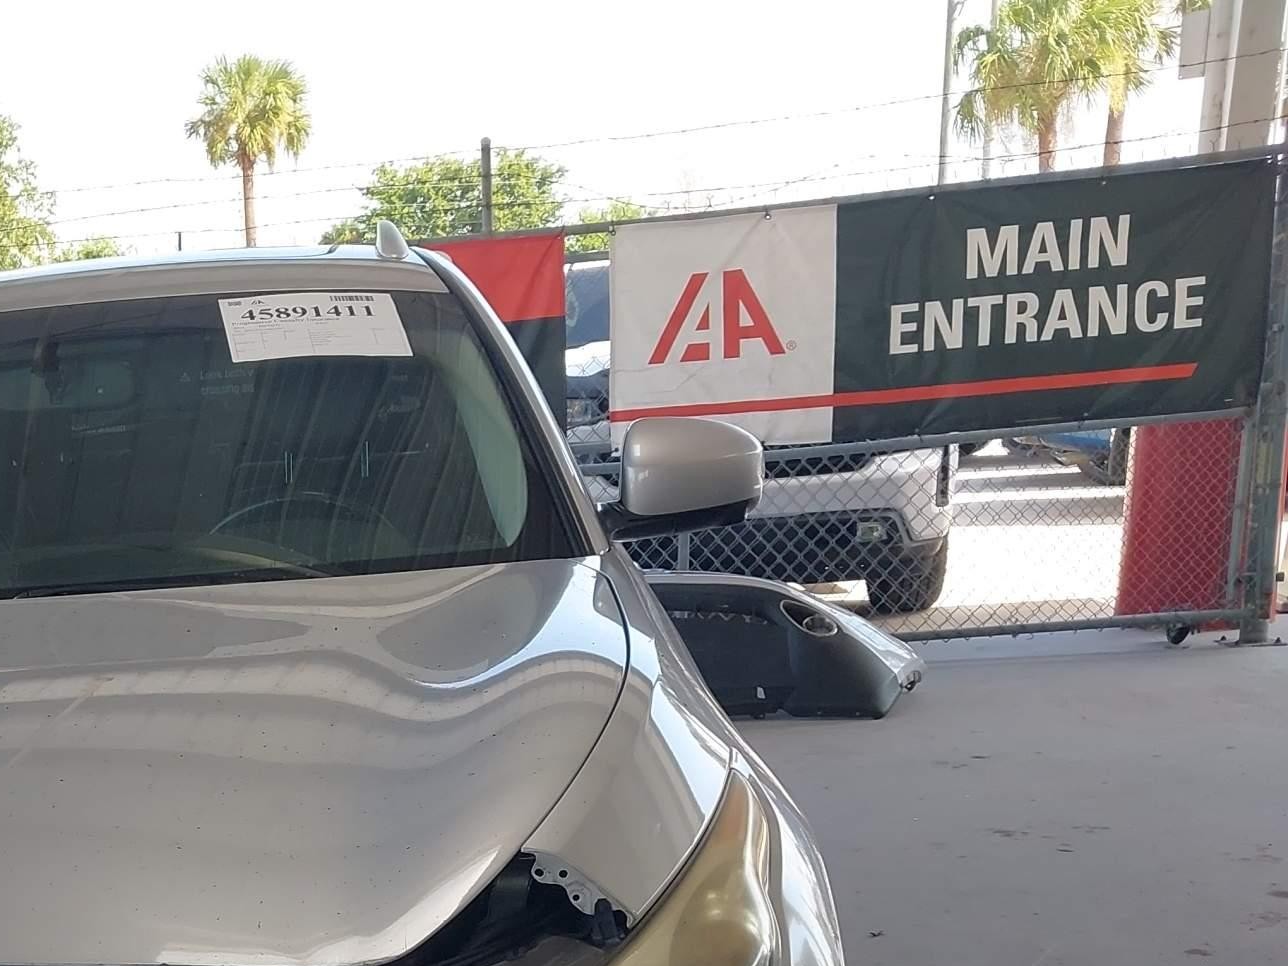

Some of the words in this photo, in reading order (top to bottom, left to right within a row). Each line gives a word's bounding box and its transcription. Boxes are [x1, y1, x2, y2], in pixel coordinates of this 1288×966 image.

[965, 214, 1132, 280] MAIN
[240, 304, 376, 321] 45891411
[889, 276, 1207, 355] ENTRANCE
